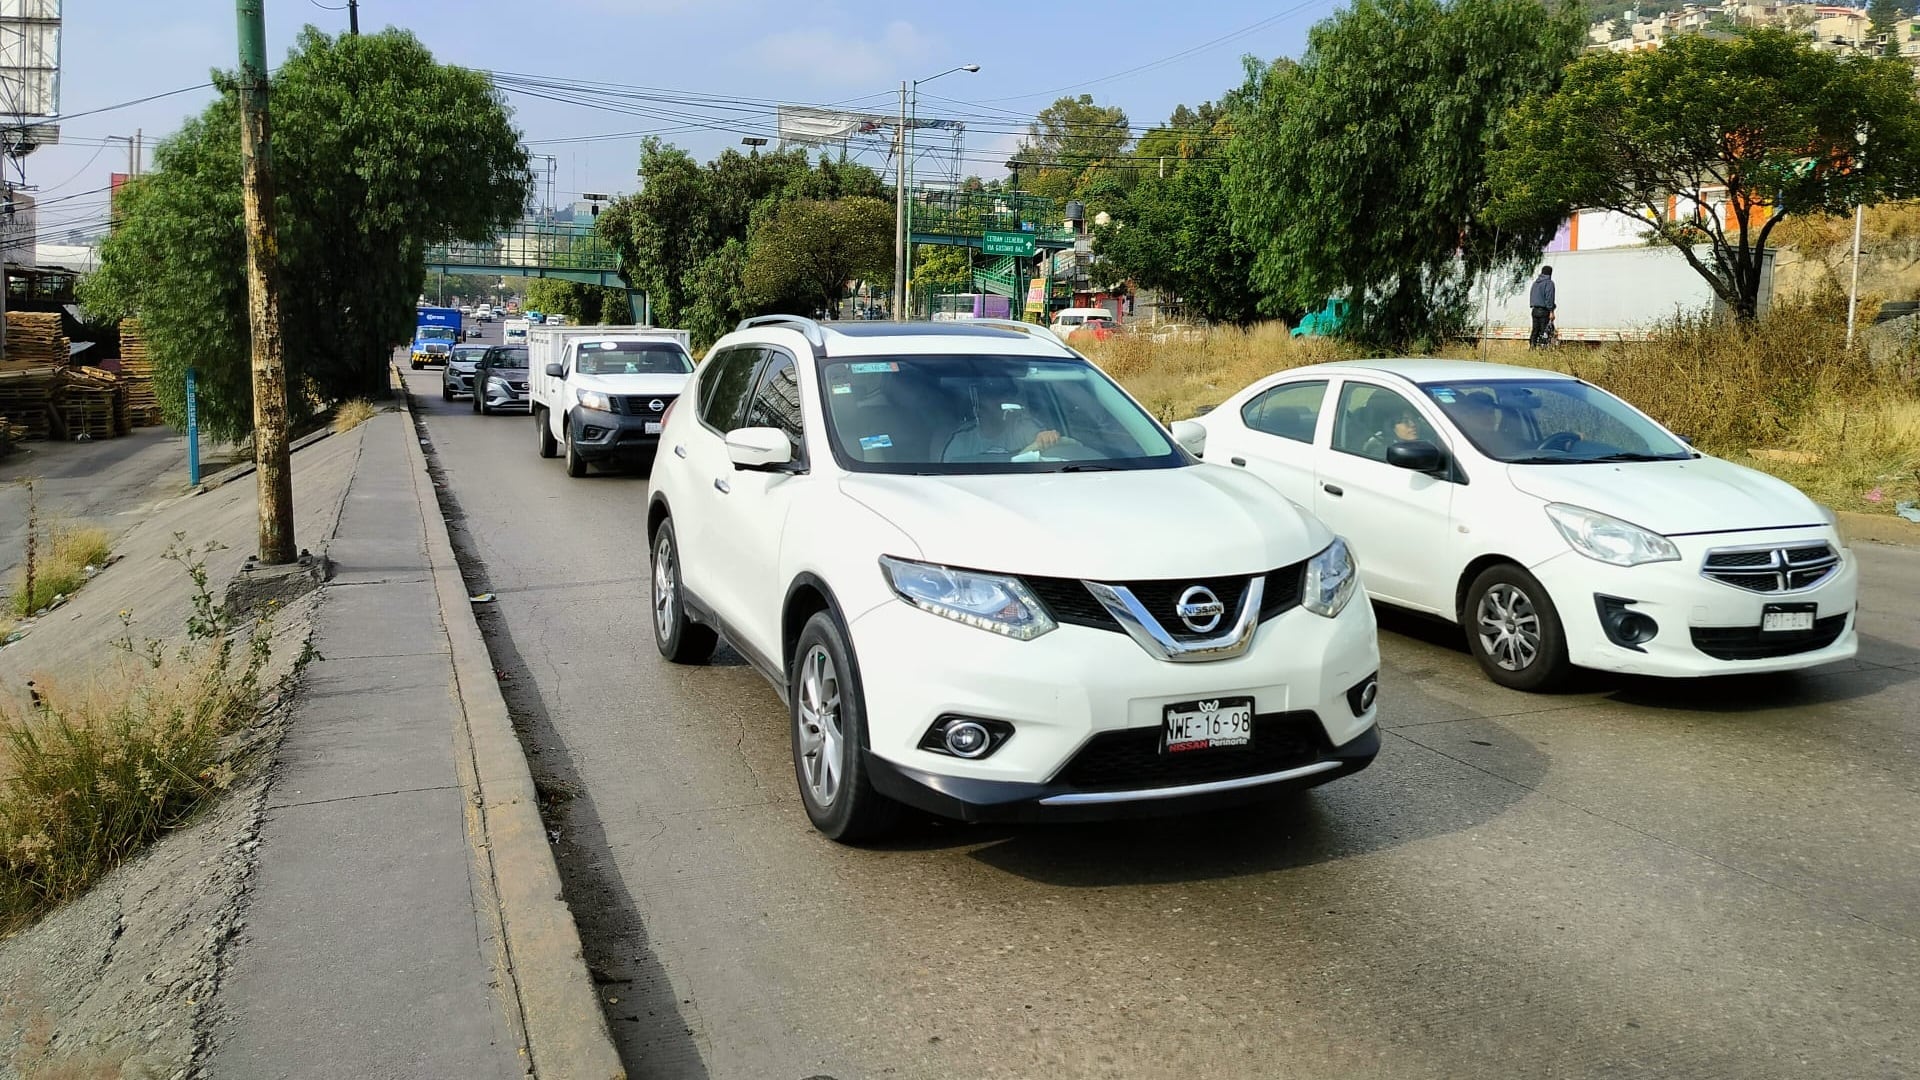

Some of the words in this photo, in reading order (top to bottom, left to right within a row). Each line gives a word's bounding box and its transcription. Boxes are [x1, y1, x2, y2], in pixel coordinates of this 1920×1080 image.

[1184, 604, 1222, 615] NISSAN
[1168, 739, 1208, 753] NISSAN
[1208, 738, 1248, 748] Perinorte
